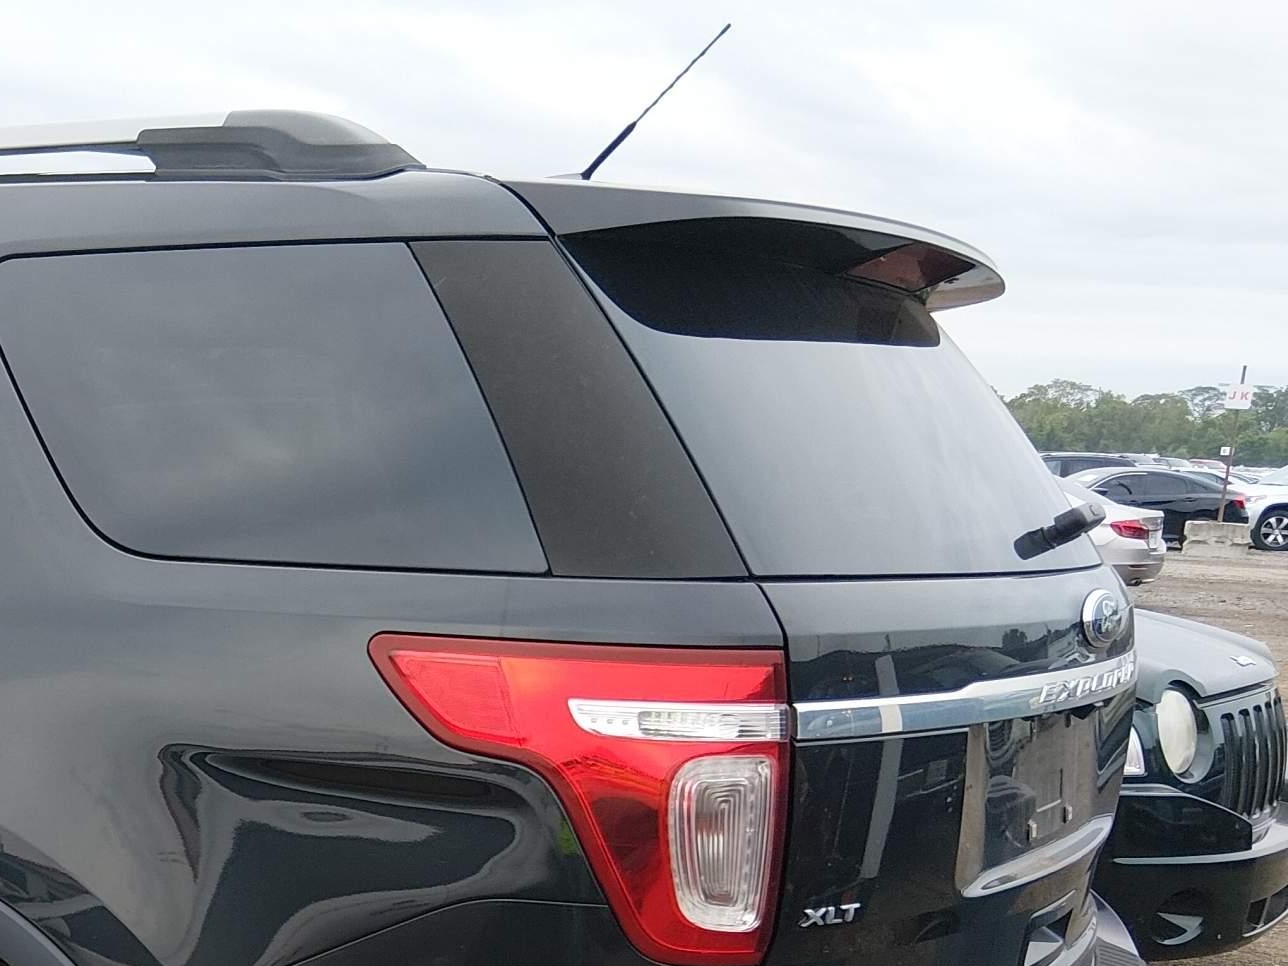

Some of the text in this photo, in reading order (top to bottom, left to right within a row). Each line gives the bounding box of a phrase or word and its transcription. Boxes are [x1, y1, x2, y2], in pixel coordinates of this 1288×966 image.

[1228, 391, 1249, 400] J K
[799, 903, 861, 927] XLT
